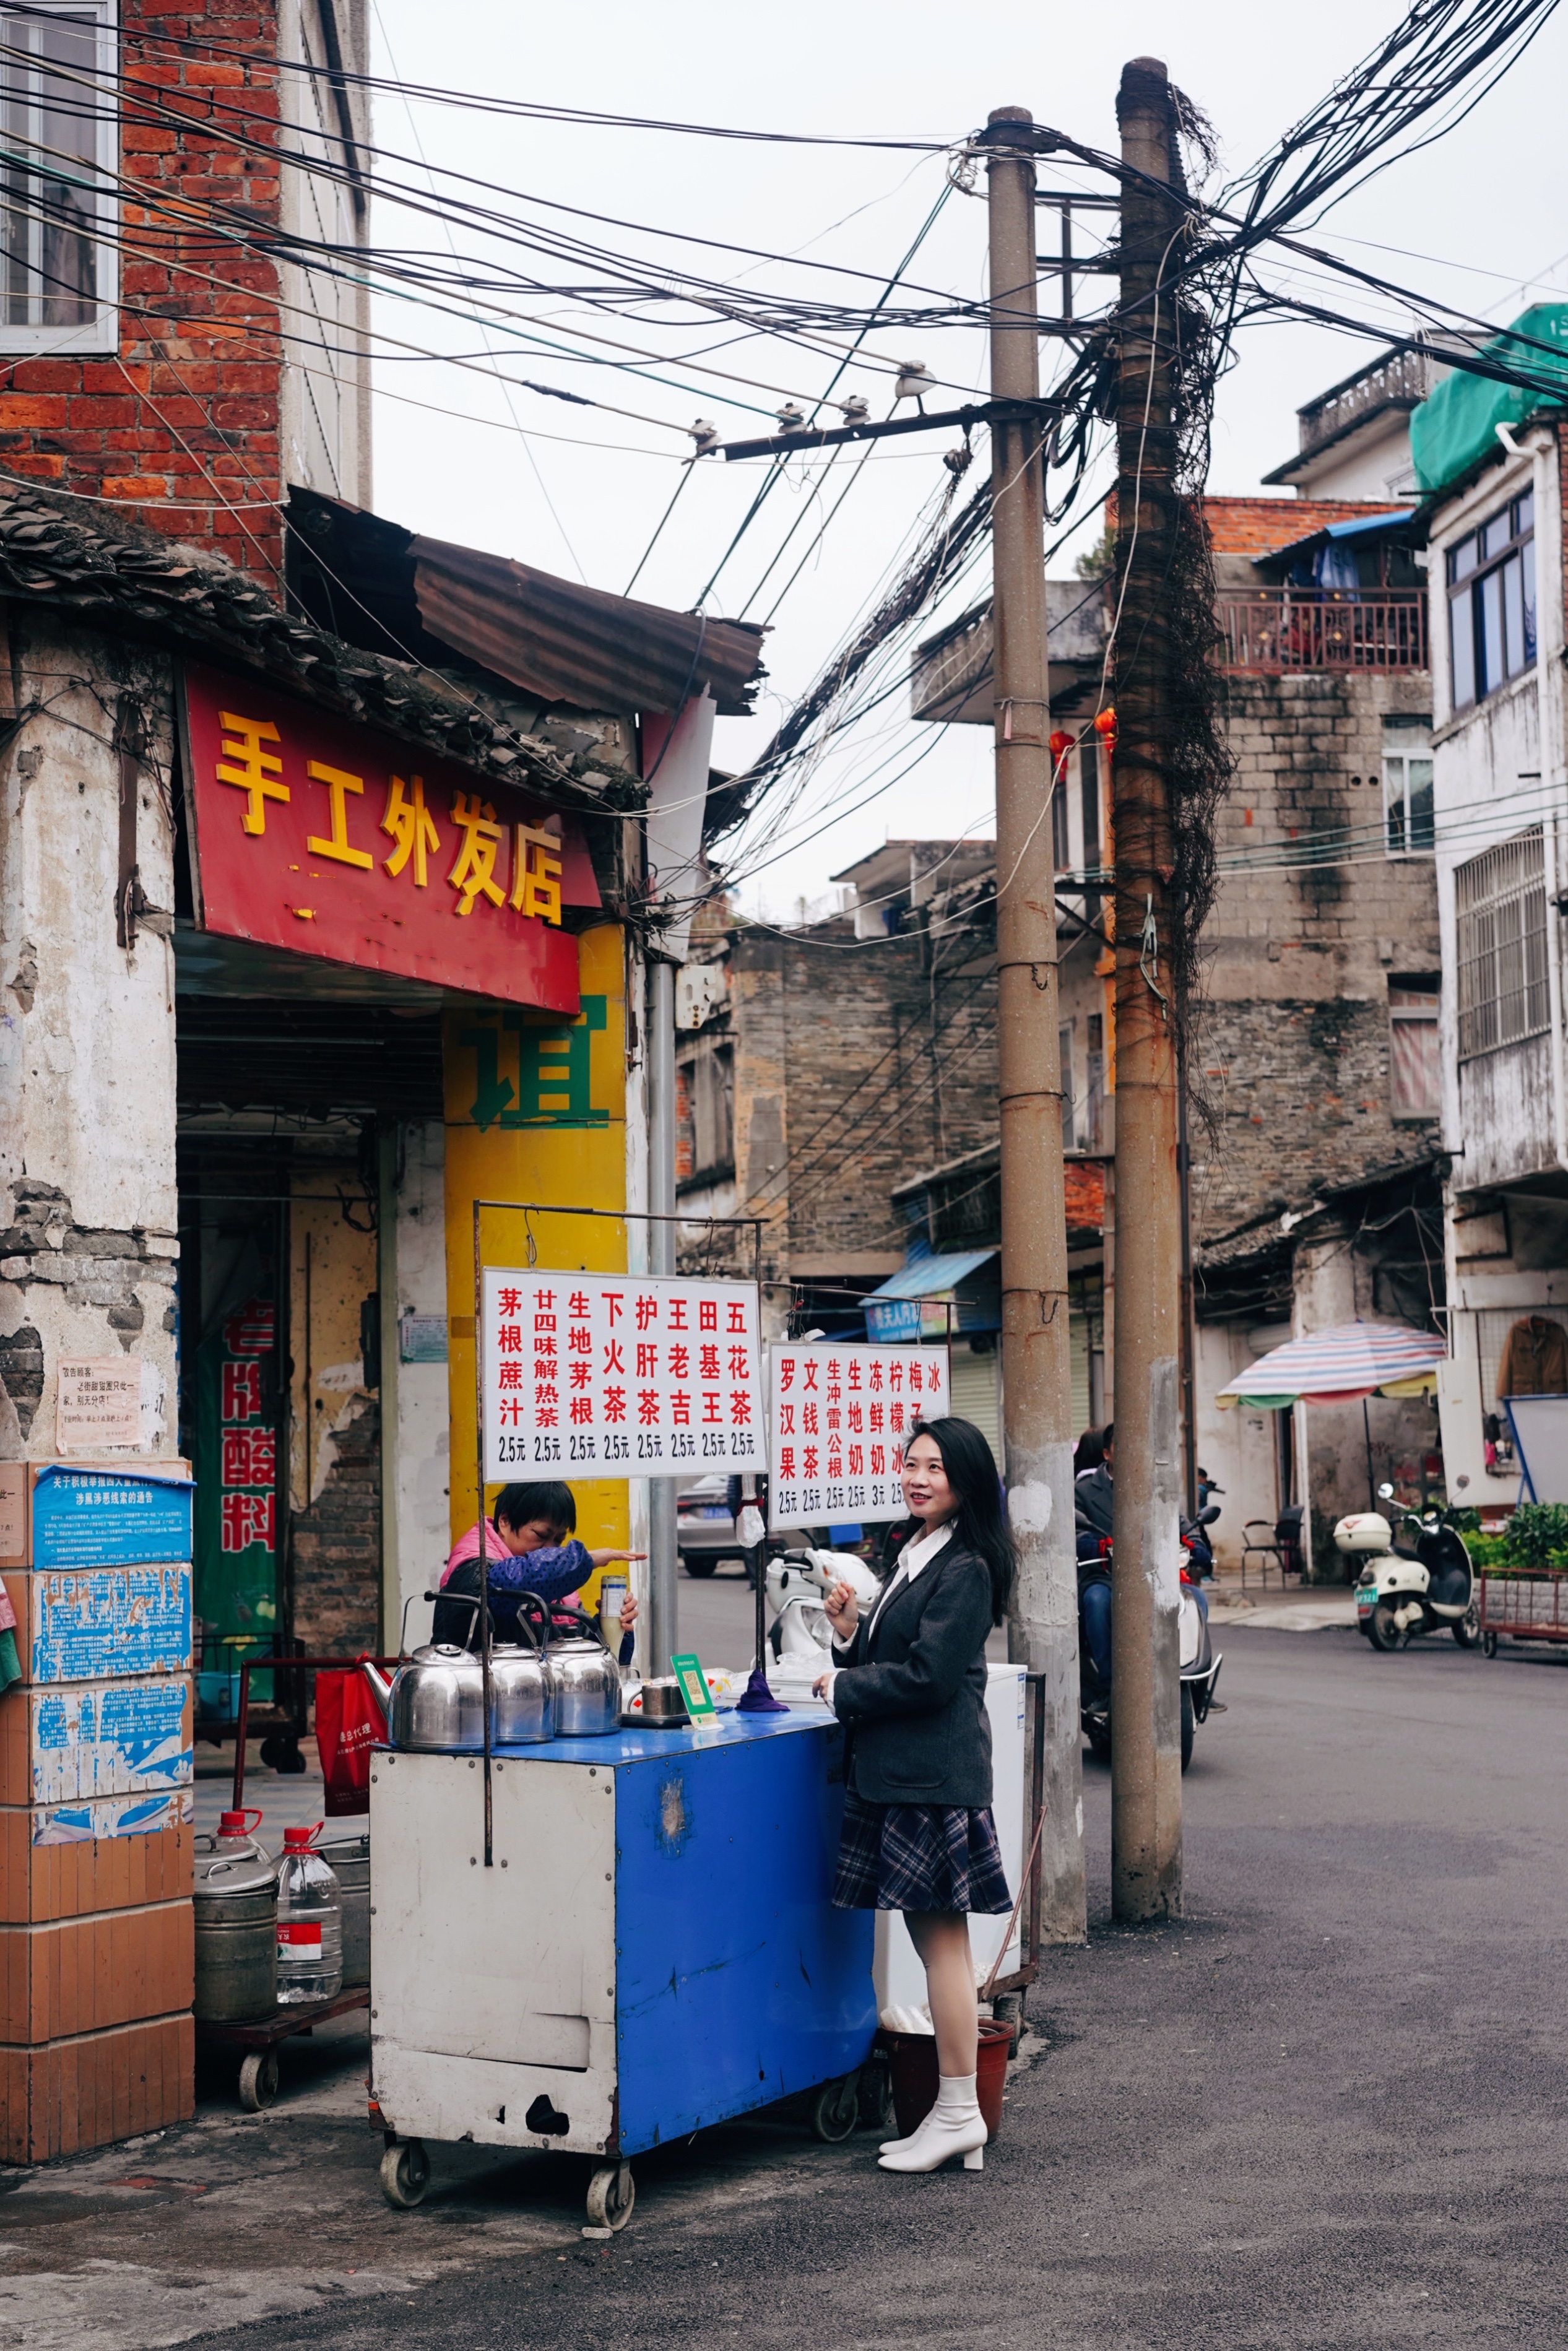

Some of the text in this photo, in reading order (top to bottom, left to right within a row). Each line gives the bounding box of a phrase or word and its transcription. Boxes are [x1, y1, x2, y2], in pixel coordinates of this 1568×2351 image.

[215, 710, 563, 926] 手工外发店
[498, 1288, 524, 1426] 茅根蔗汁
[533, 1289, 559, 1427] 廿四味解热茶
[568, 1291, 593, 1425] 生地茅根
[601, 1292, 626, 1423] 下火茶
[636, 1295, 661, 1426] 护肝茶
[667, 1299, 691, 1425] 王老吉
[700, 1301, 723, 1423] 田基王
[726, 1302, 752, 1425] 五花茶
[499, 1436, 526, 1462] 2.5元
[535, 1436, 561, 1461] 2.5元
[570, 1435, 596, 1460] 2.5元
[604, 1435, 630, 1460] 2.5元
[638, 1434, 662, 1458] 2.5元
[671, 1434, 695, 1457] 2.5元
[703, 1433, 726, 1457] 2.5元
[731, 1432, 755, 1455] 2.5元
[780, 1359, 795, 1481] 罗汉果
[802, 1357, 819, 1479] 文钱茶
[826, 1359, 842, 1479] 生冲雷公根
[847, 1359, 864, 1476] 生地奶
[869, 1360, 885, 1475] 冻鲜奶
[779, 1491, 797, 1514] 2.5元
[803, 1489, 821, 1512] 2.5元
[826, 1487, 844, 1509] 2.5元
[848, 1486, 865, 1508] 2.5元
[872, 1485, 885, 1506] 3元
[891, 1483, 905, 1504] 2.5
